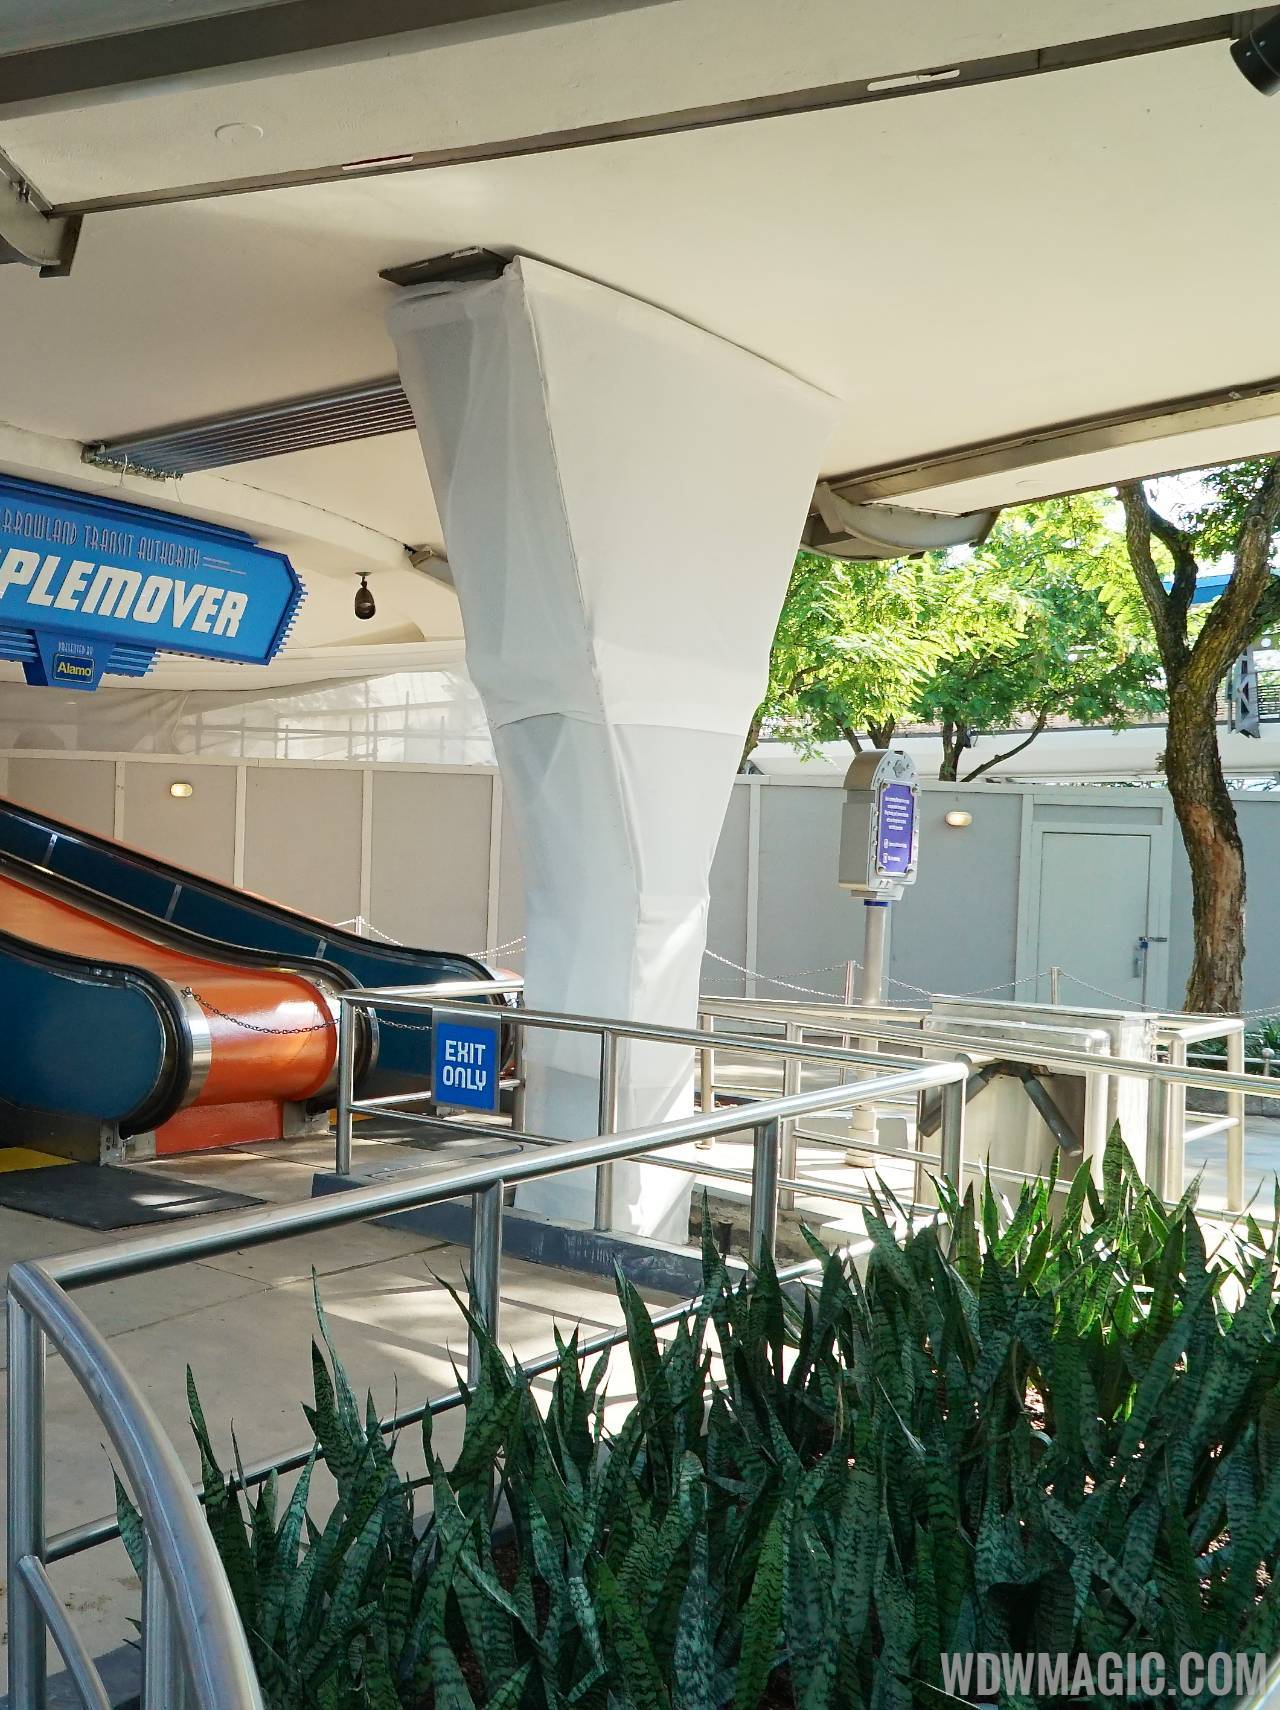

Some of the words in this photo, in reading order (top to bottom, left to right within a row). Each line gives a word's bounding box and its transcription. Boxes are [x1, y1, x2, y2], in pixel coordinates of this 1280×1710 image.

[83, 525, 135, 558] TRANSIT
[137, 536, 201, 571] AUTHORITY
[57, 661, 92, 677] Alamo
[445, 1039, 486, 1066] EXIT
[442, 1065, 487, 1092] ONLY
